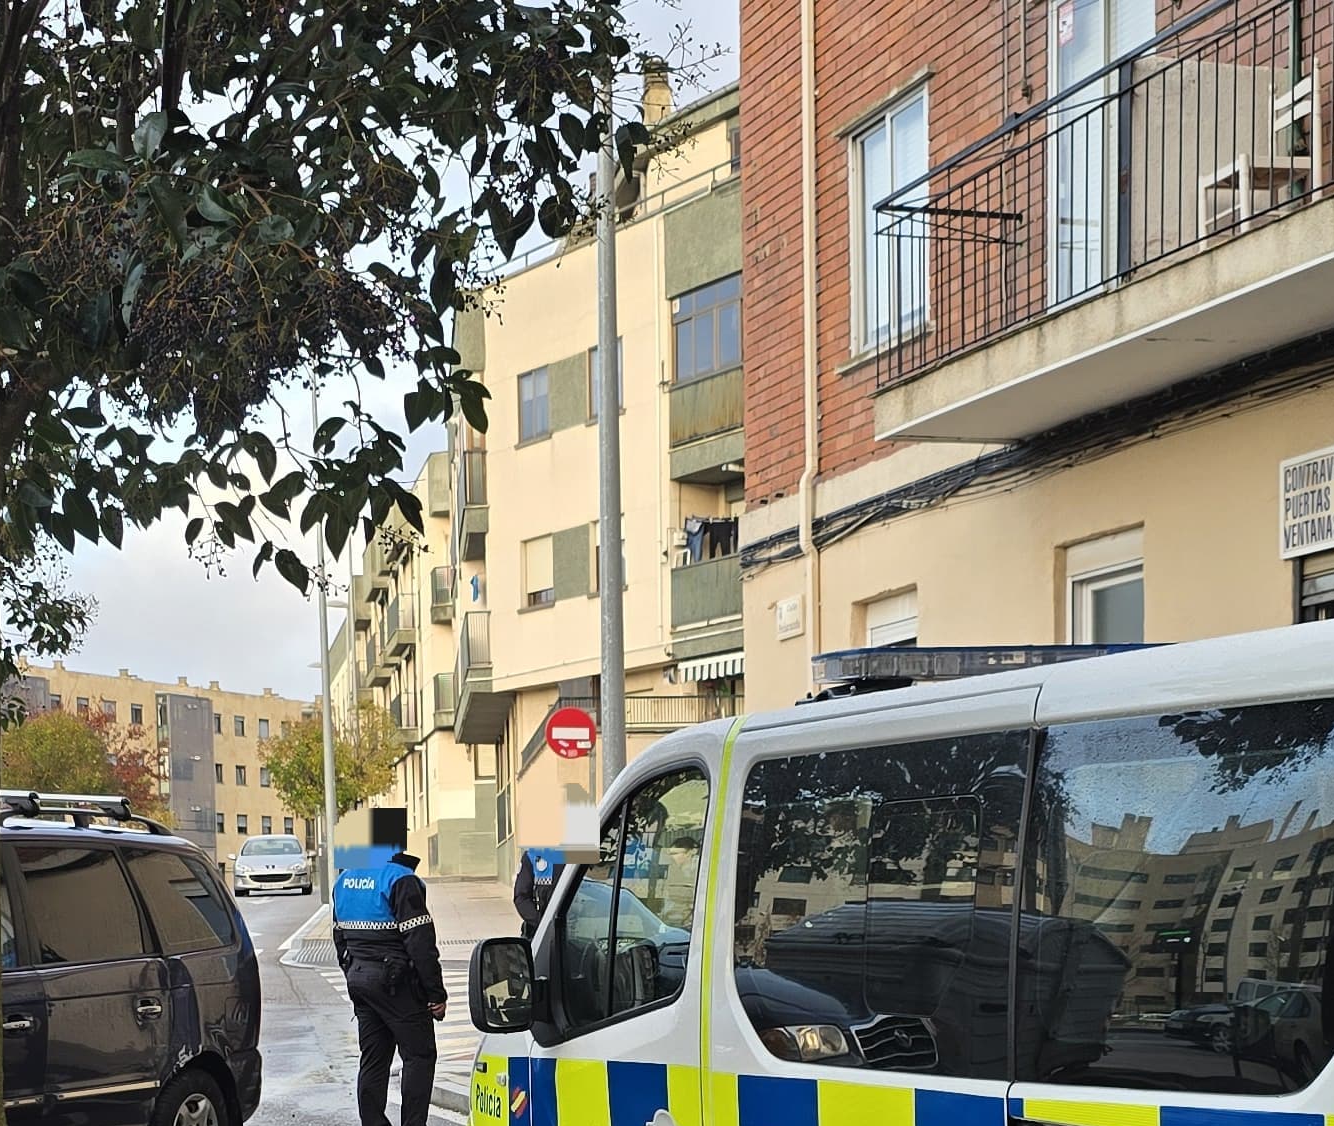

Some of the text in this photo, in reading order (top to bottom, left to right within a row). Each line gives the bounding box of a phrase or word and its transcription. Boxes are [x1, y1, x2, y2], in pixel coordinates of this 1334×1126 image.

[1284, 486, 1331, 521] PUERTAS
[343, 876, 375, 890] POLICÍA
[475, 1083, 502, 1118] Policía
